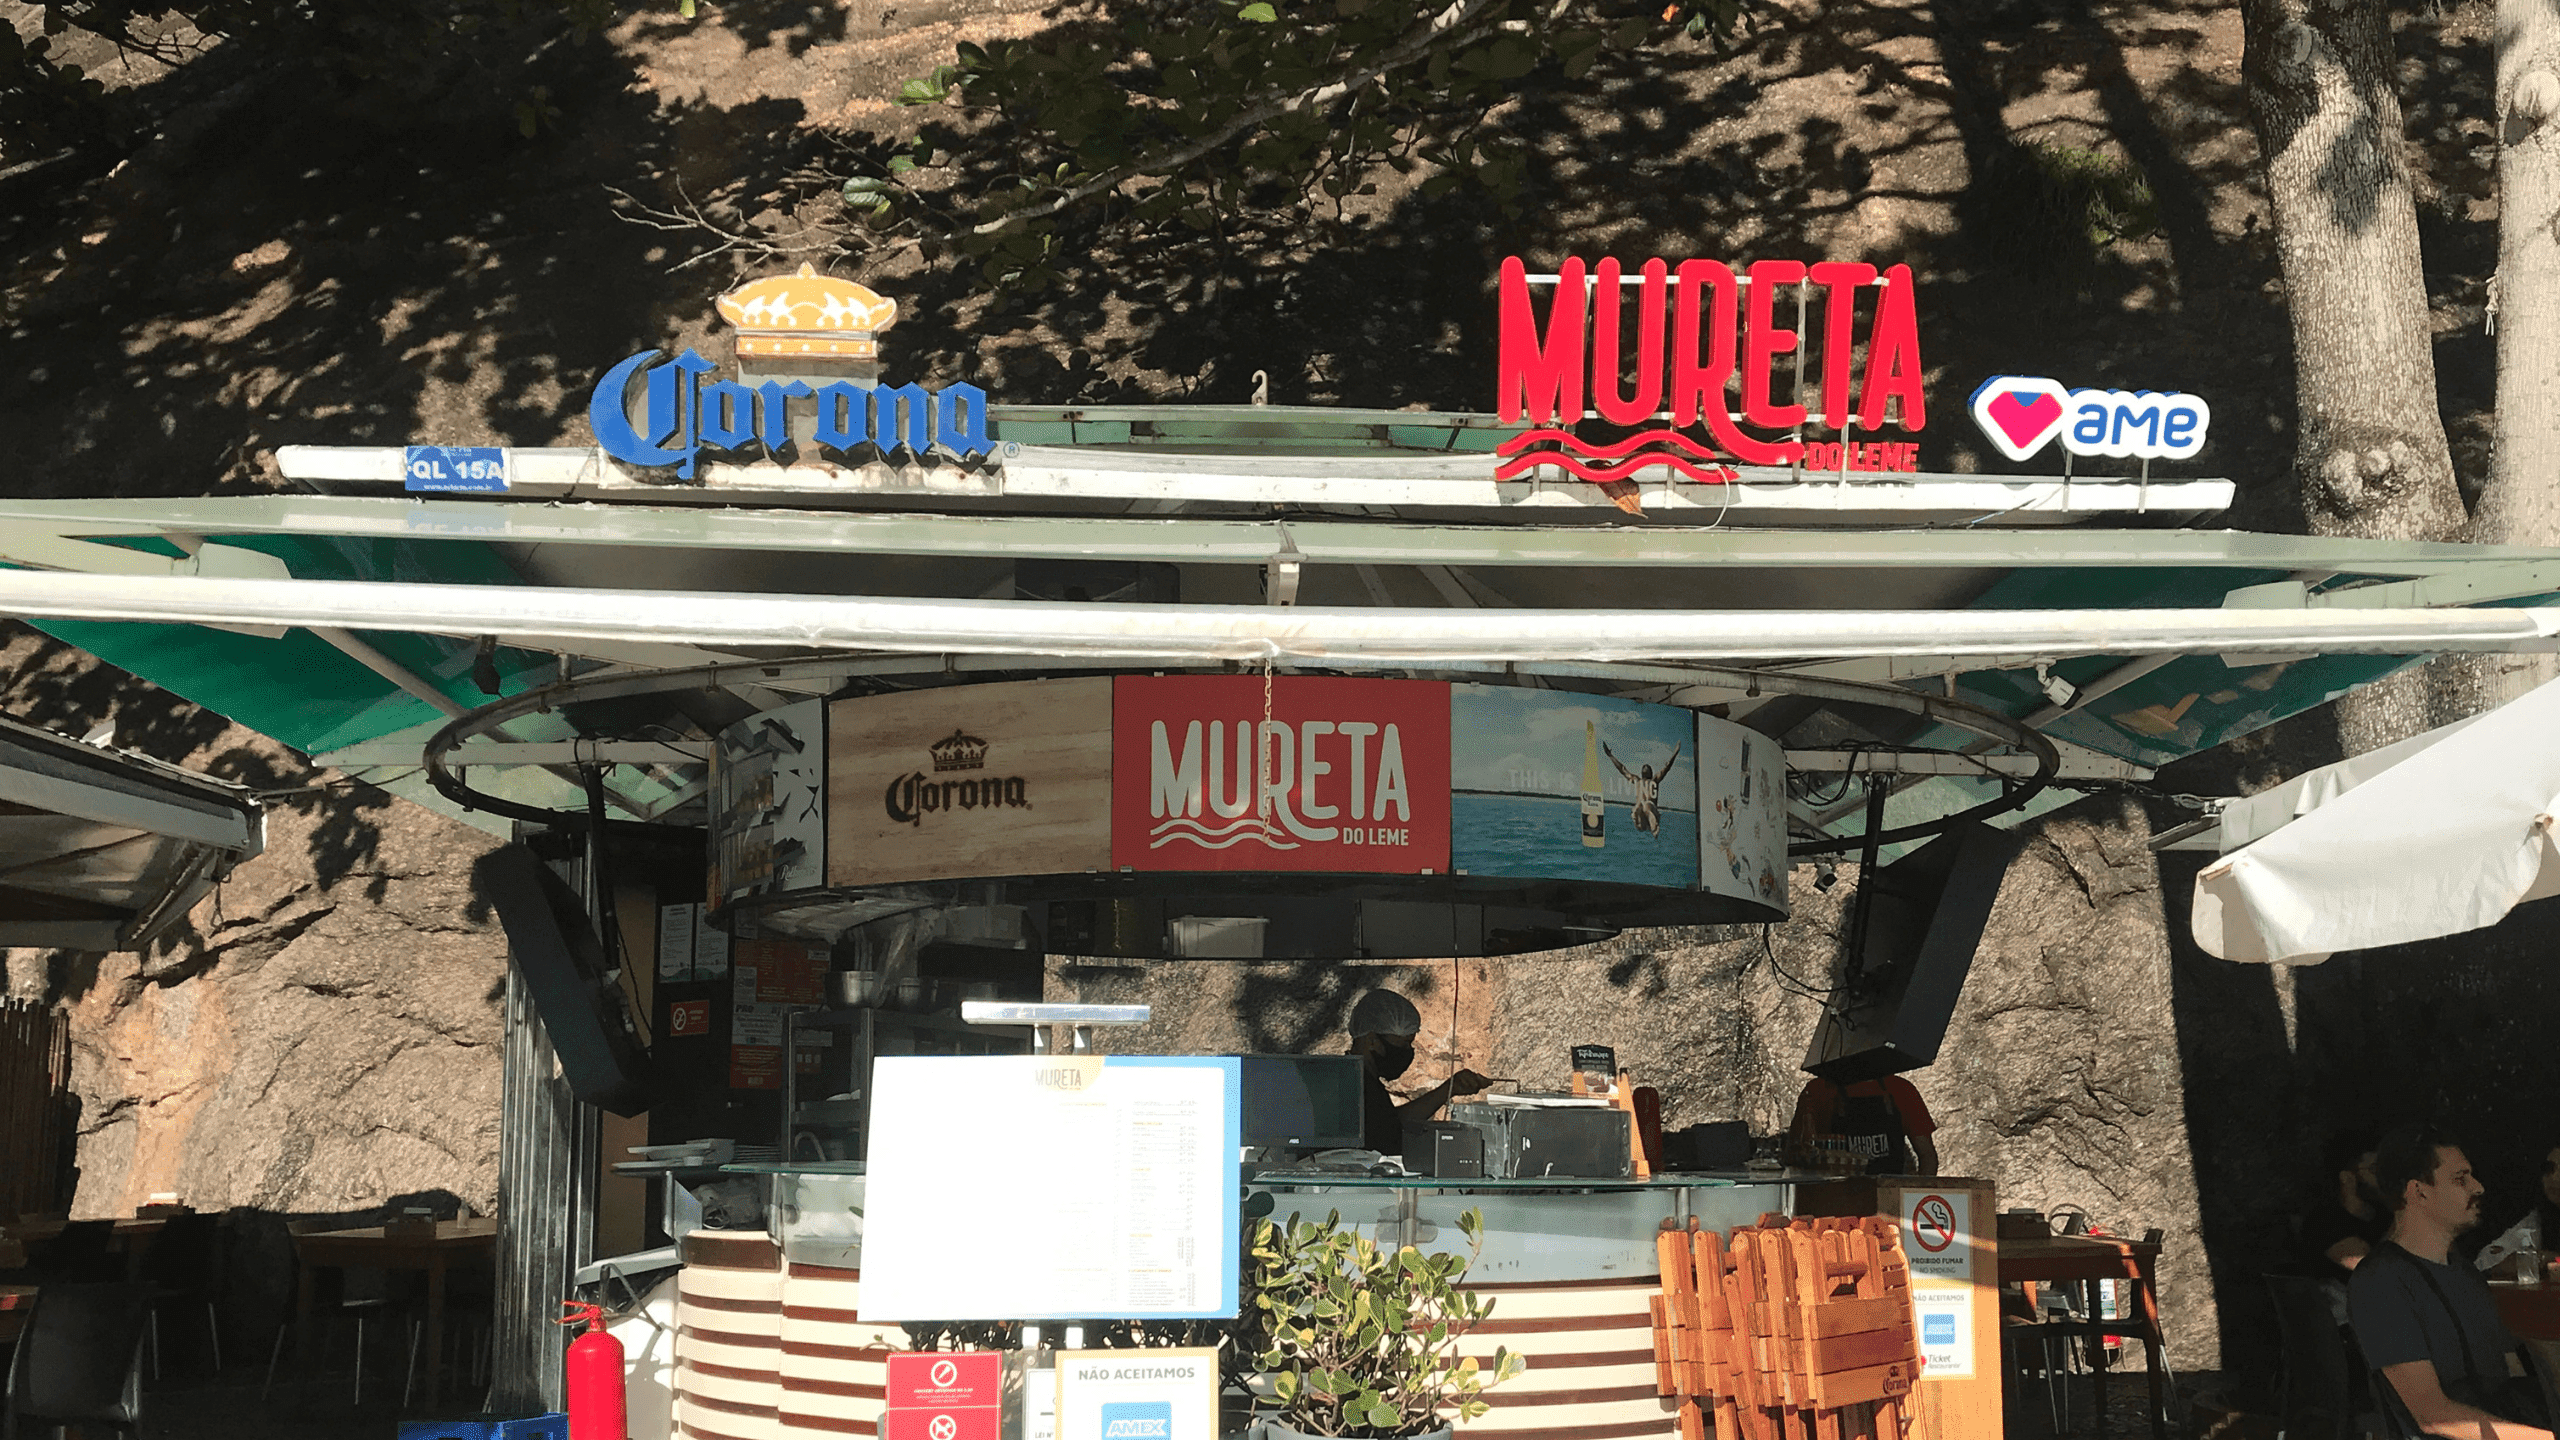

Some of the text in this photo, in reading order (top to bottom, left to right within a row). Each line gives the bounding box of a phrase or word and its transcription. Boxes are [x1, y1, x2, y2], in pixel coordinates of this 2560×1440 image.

[1497, 255, 1927, 464] MURETA
[589, 347, 998, 480] Corona
[1804, 442, 1920, 473] DO LEME
[412, 459, 504, 480] QL 15A
[1150, 720, 1411, 842] MURETA
[1509, 768, 1549, 789] THIS
[1559, 771, 1575, 791] IS
[885, 771, 1028, 827] Corona
[1342, 827, 1410, 846] DO LEME
[1034, 1068, 1082, 1090] MURETA
[1847, 1134, 1890, 1158] MURETA
[1928, 1294, 1965, 1302] ACEITAMOS
[1078, 1366, 1195, 1381] NÃO ACEITAMOS
[1105, 1419, 1168, 1438] AMEX
